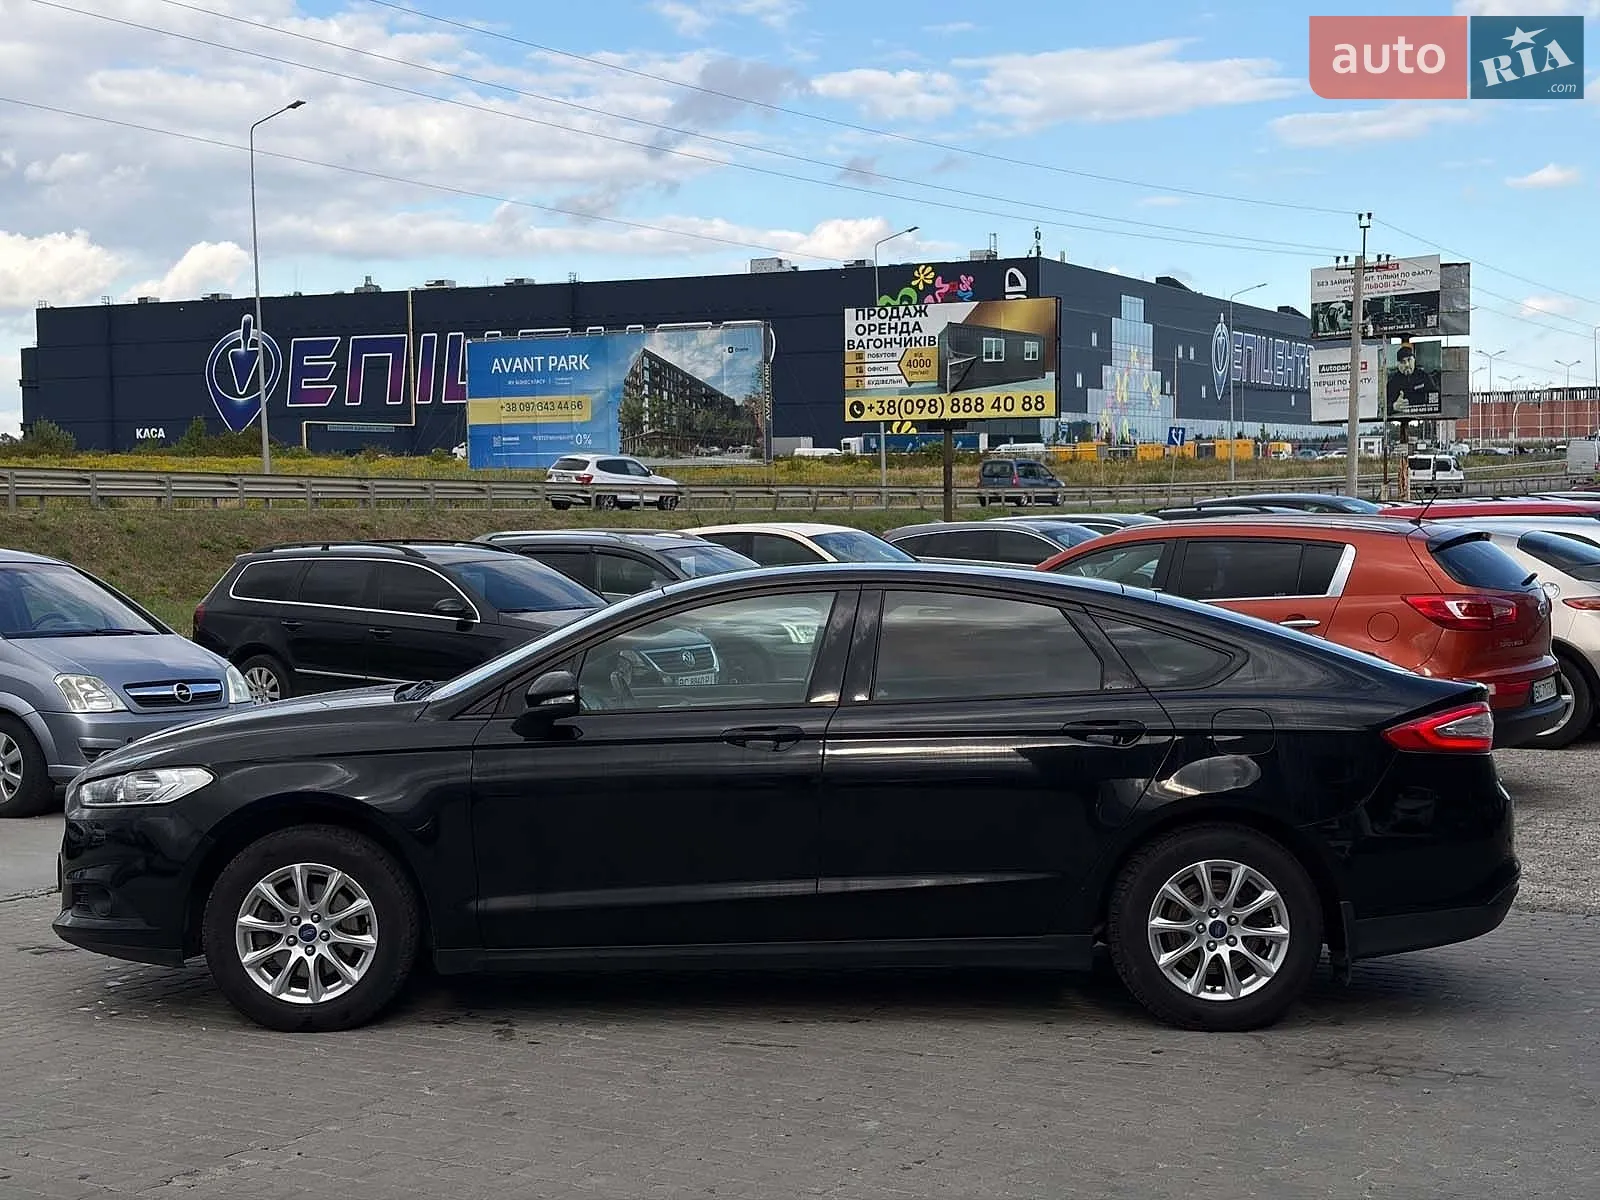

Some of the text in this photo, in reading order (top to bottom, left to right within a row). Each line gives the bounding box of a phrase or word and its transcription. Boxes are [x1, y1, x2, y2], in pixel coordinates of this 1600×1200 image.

[855, 306, 929, 322] ПРОДАЖ
[855, 321, 923, 337] ОРЕНДА
[847, 335, 937, 350] ВАГОНЧИКІВ
[491, 354, 590, 374] AVANT PARK
[906, 358, 931, 369] 4000
[867, 395, 1046, 419] +38(098) 888 40 88
[135, 427, 165, 440] КАСА
[575, 433, 592, 445] 0%
